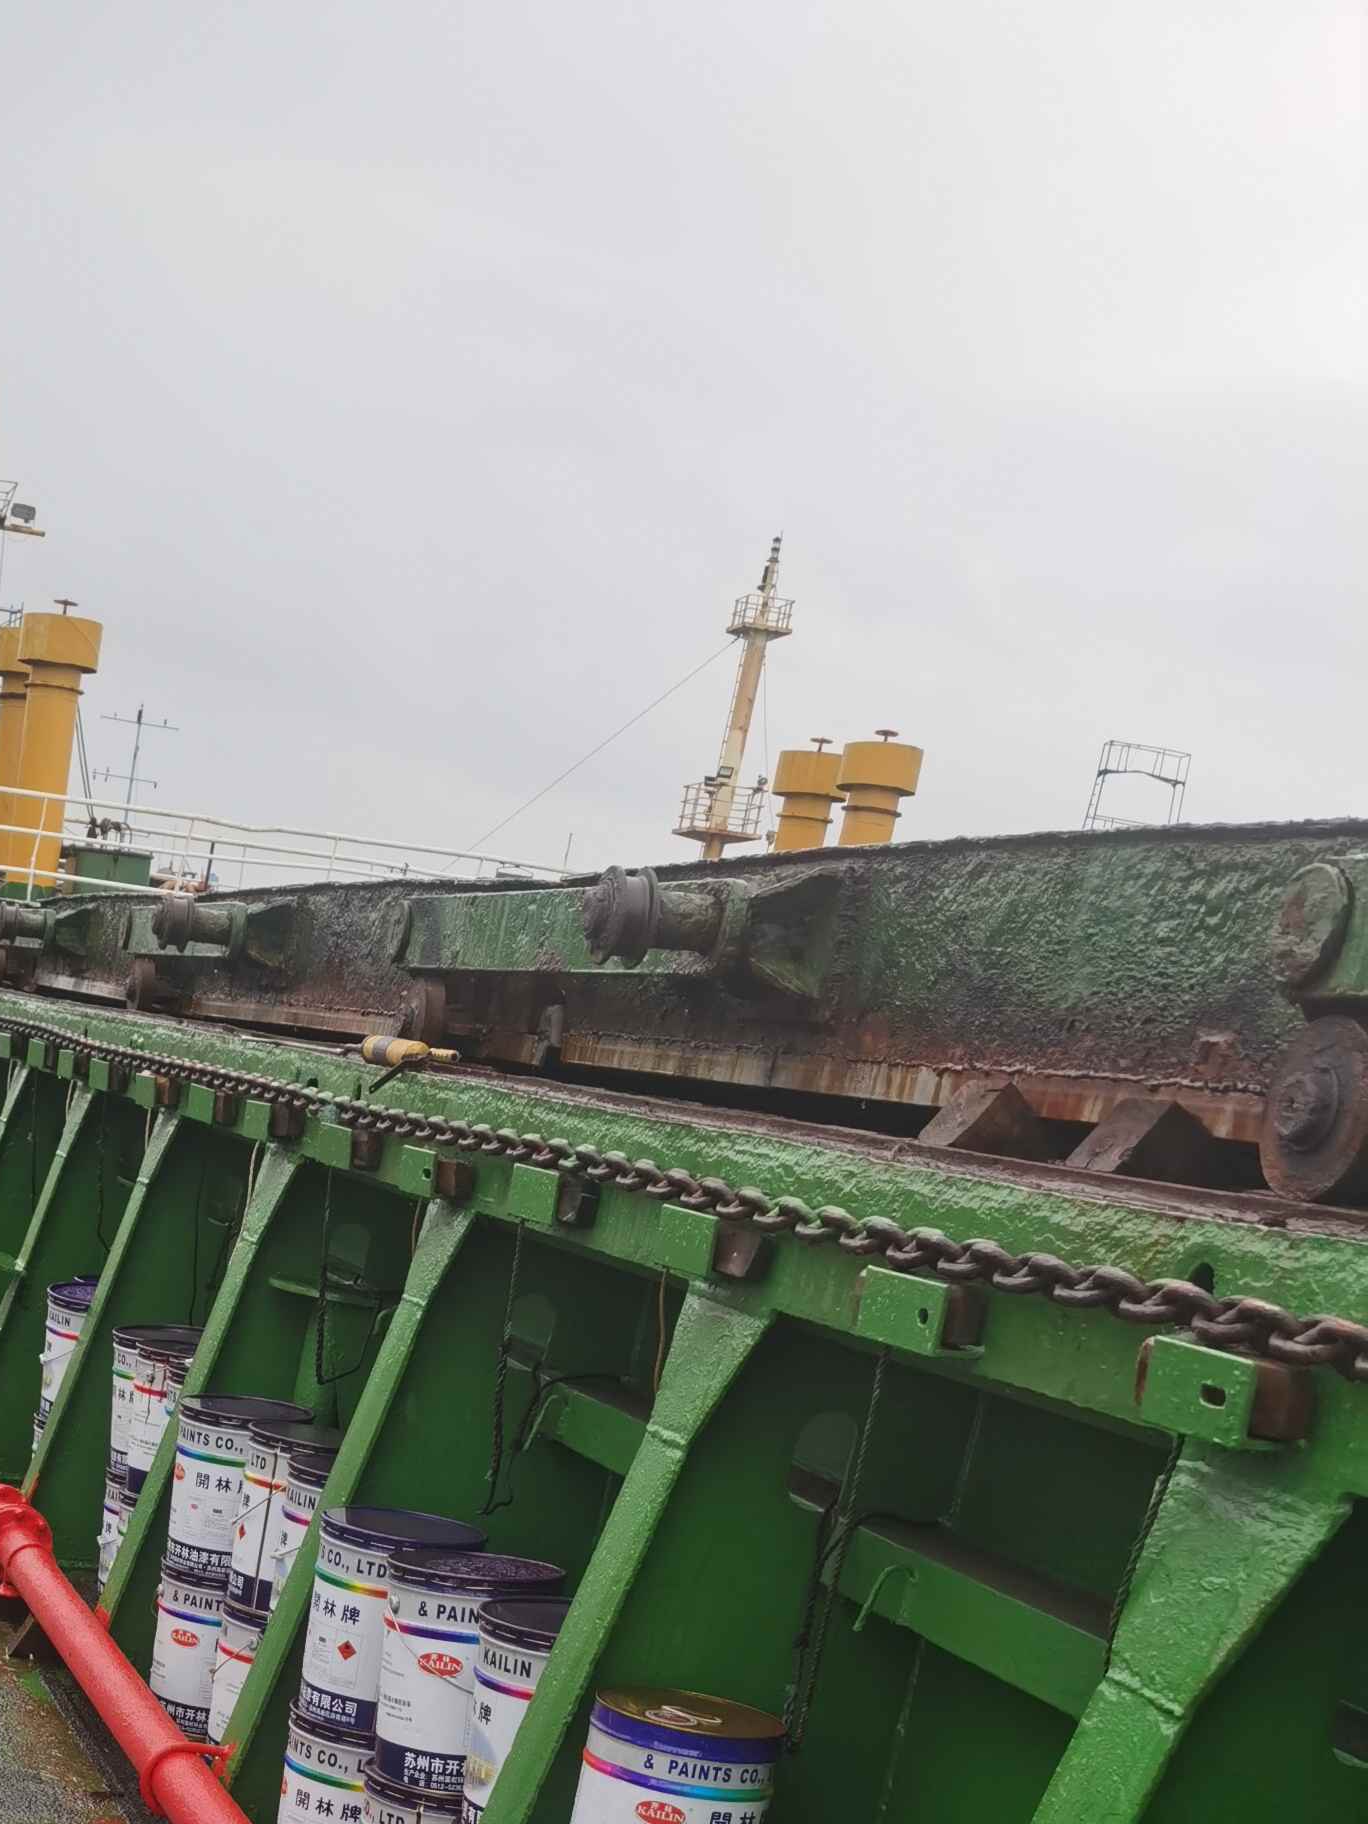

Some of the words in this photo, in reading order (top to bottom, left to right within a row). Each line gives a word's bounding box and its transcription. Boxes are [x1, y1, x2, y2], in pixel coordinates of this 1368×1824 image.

[216, 1437, 244, 1452] CO.,
[251, 1454, 266, 1470] LTD
[327, 1548, 350, 1573] CO.,
[356, 1558, 387, 1578] LTD
[173, 1590, 179, 1602] &
[184, 1593, 223, 1612] PAINT
[418, 1601, 429, 1617] &
[437, 1604, 479, 1624] PAIN
[483, 1650, 532, 1678] KAILIN
[317, 1750, 349, 1774] CO.,
[644, 1754, 654, 1770] &
[668, 1759, 733, 1783] PAINTS
[296, 1788, 361, 1823] 開林牌
[637, 1805, 685, 1823] KAILIN
